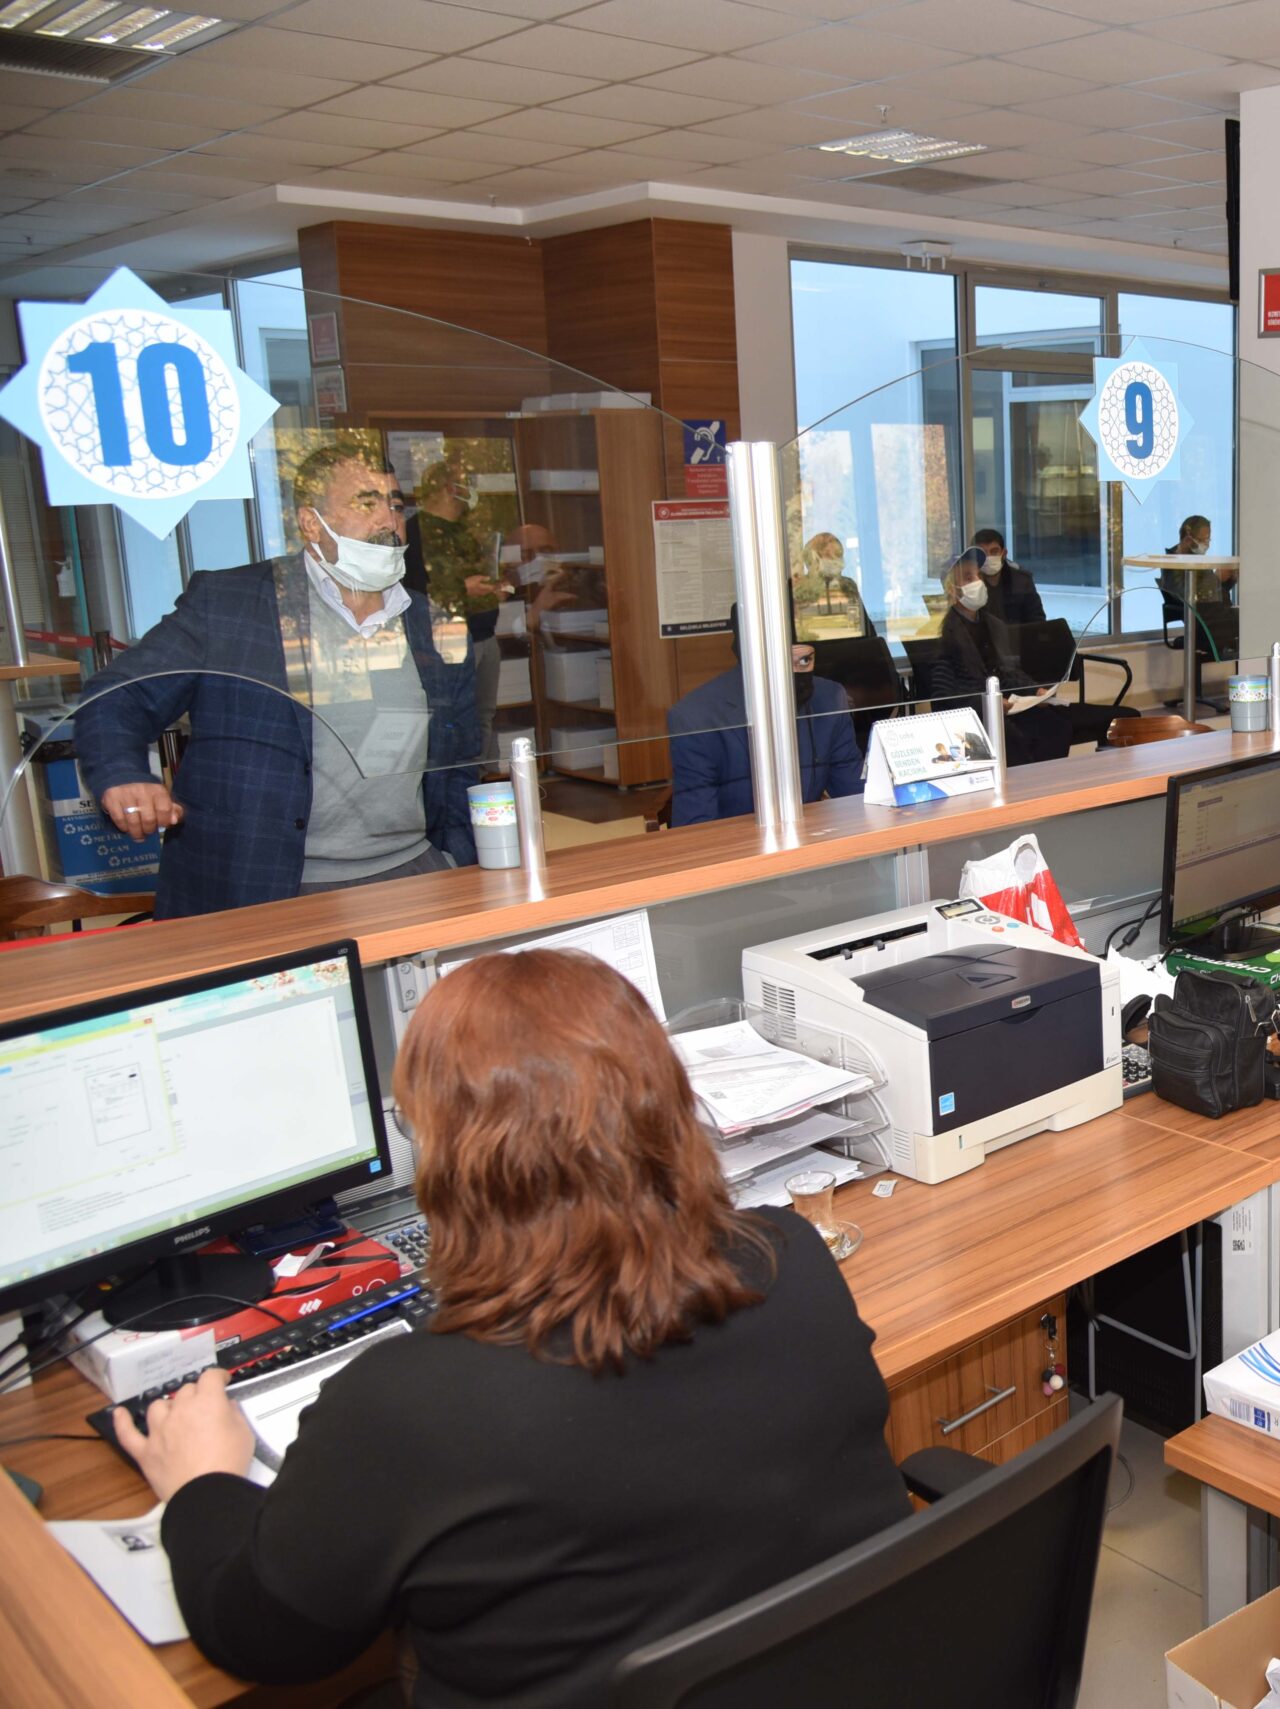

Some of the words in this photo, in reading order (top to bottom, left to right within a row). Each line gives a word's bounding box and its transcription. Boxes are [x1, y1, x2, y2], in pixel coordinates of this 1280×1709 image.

[67, 342, 215, 467] 10
[1124, 381, 1155, 460] 9
[174, 1225, 212, 1246] PHILIPS
